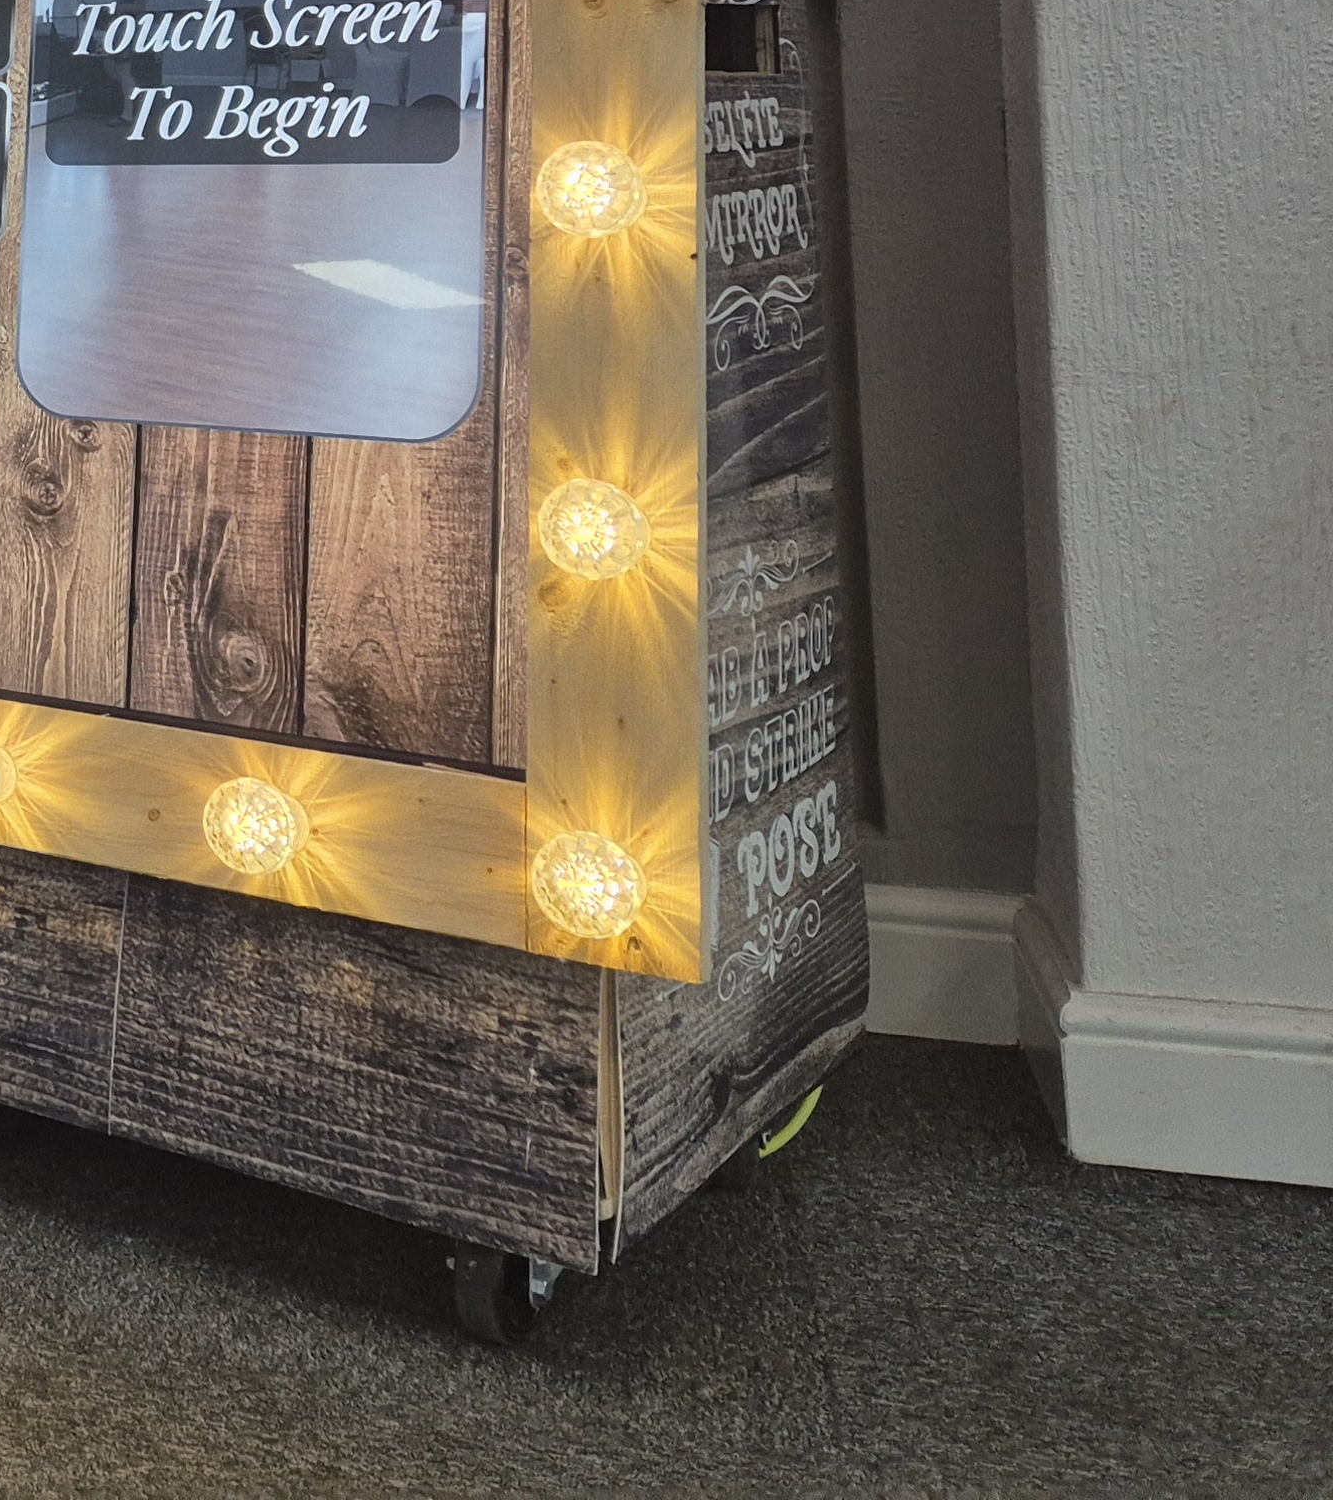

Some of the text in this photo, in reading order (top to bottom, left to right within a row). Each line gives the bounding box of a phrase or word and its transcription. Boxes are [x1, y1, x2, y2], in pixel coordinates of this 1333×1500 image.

[126, 82, 371, 158] To Begin
[705, 184, 809, 266] MIRROR
[750, 630, 770, 708] A
[778, 595, 835, 694] PROP
[709, 684, 837, 826] D STRIKE
[737, 780, 841, 919] POSE
